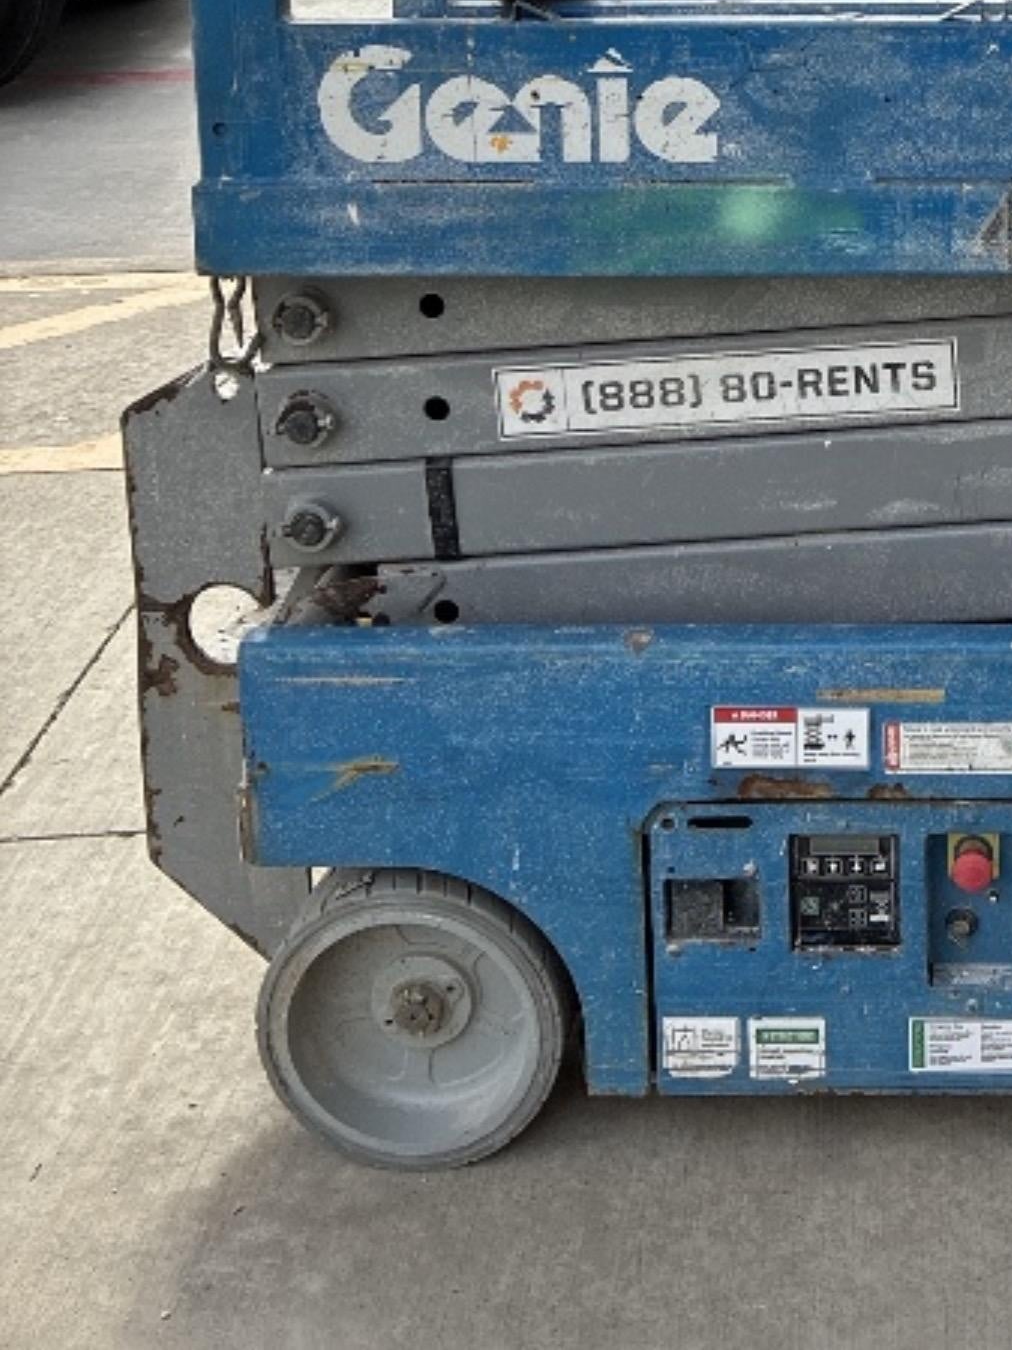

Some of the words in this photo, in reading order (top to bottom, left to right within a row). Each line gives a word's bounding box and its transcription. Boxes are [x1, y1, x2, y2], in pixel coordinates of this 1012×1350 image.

[317, 43, 721, 164] Genie
[581, 372, 704, 415] (888)
[718, 360, 937, 404] 80-RENTS
